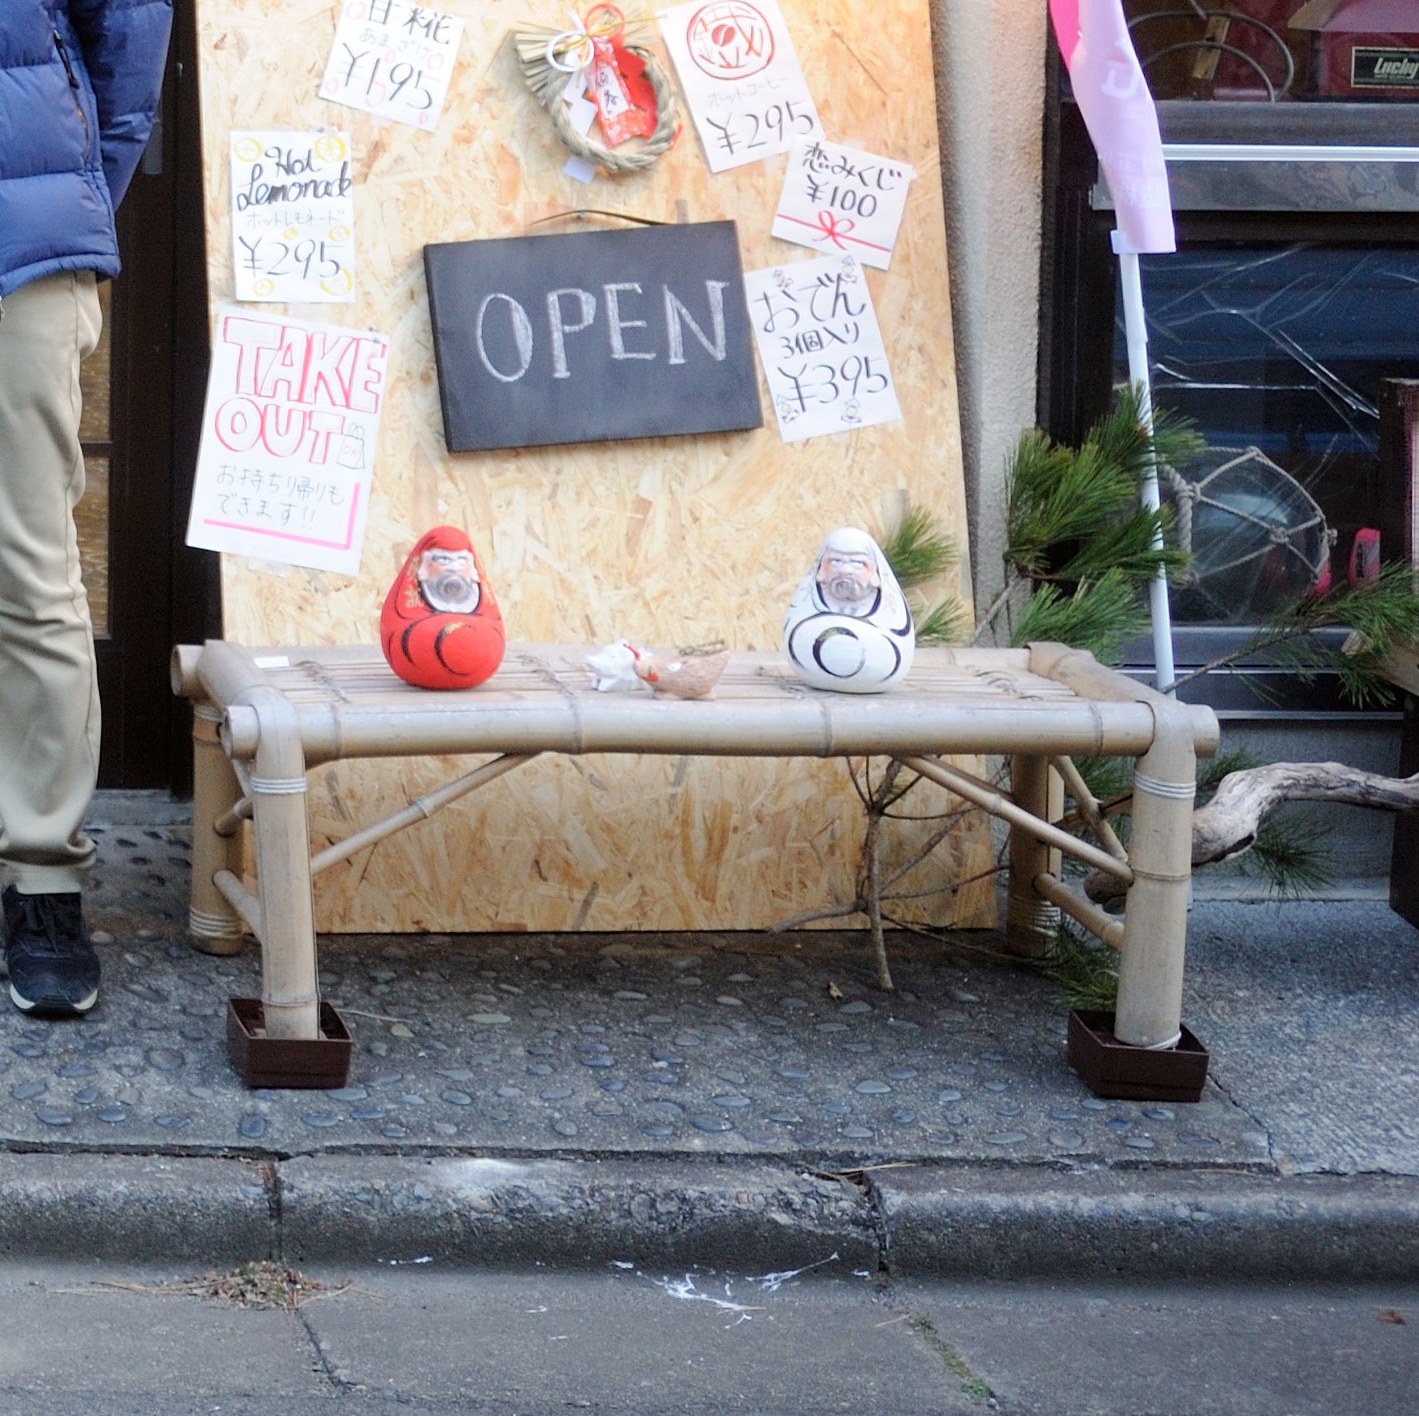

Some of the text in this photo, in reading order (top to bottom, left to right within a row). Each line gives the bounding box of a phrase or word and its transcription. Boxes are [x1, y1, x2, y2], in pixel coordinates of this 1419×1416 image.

[705, 100, 815, 156] ¥295
[264, 146, 323, 178] Hot
[802, 142, 903, 191] 恋みくじ
[804, 174, 878, 218] ¥100
[238, 235, 346, 281] ¥295
[475, 279, 730, 383] OPEN
[754, 273, 867, 333] おでん
[222, 316, 388, 415] TAKE
[780, 321, 861, 359] 3個入り
[777, 355, 889, 414] ¥395
[214, 396, 347, 465] OUT
